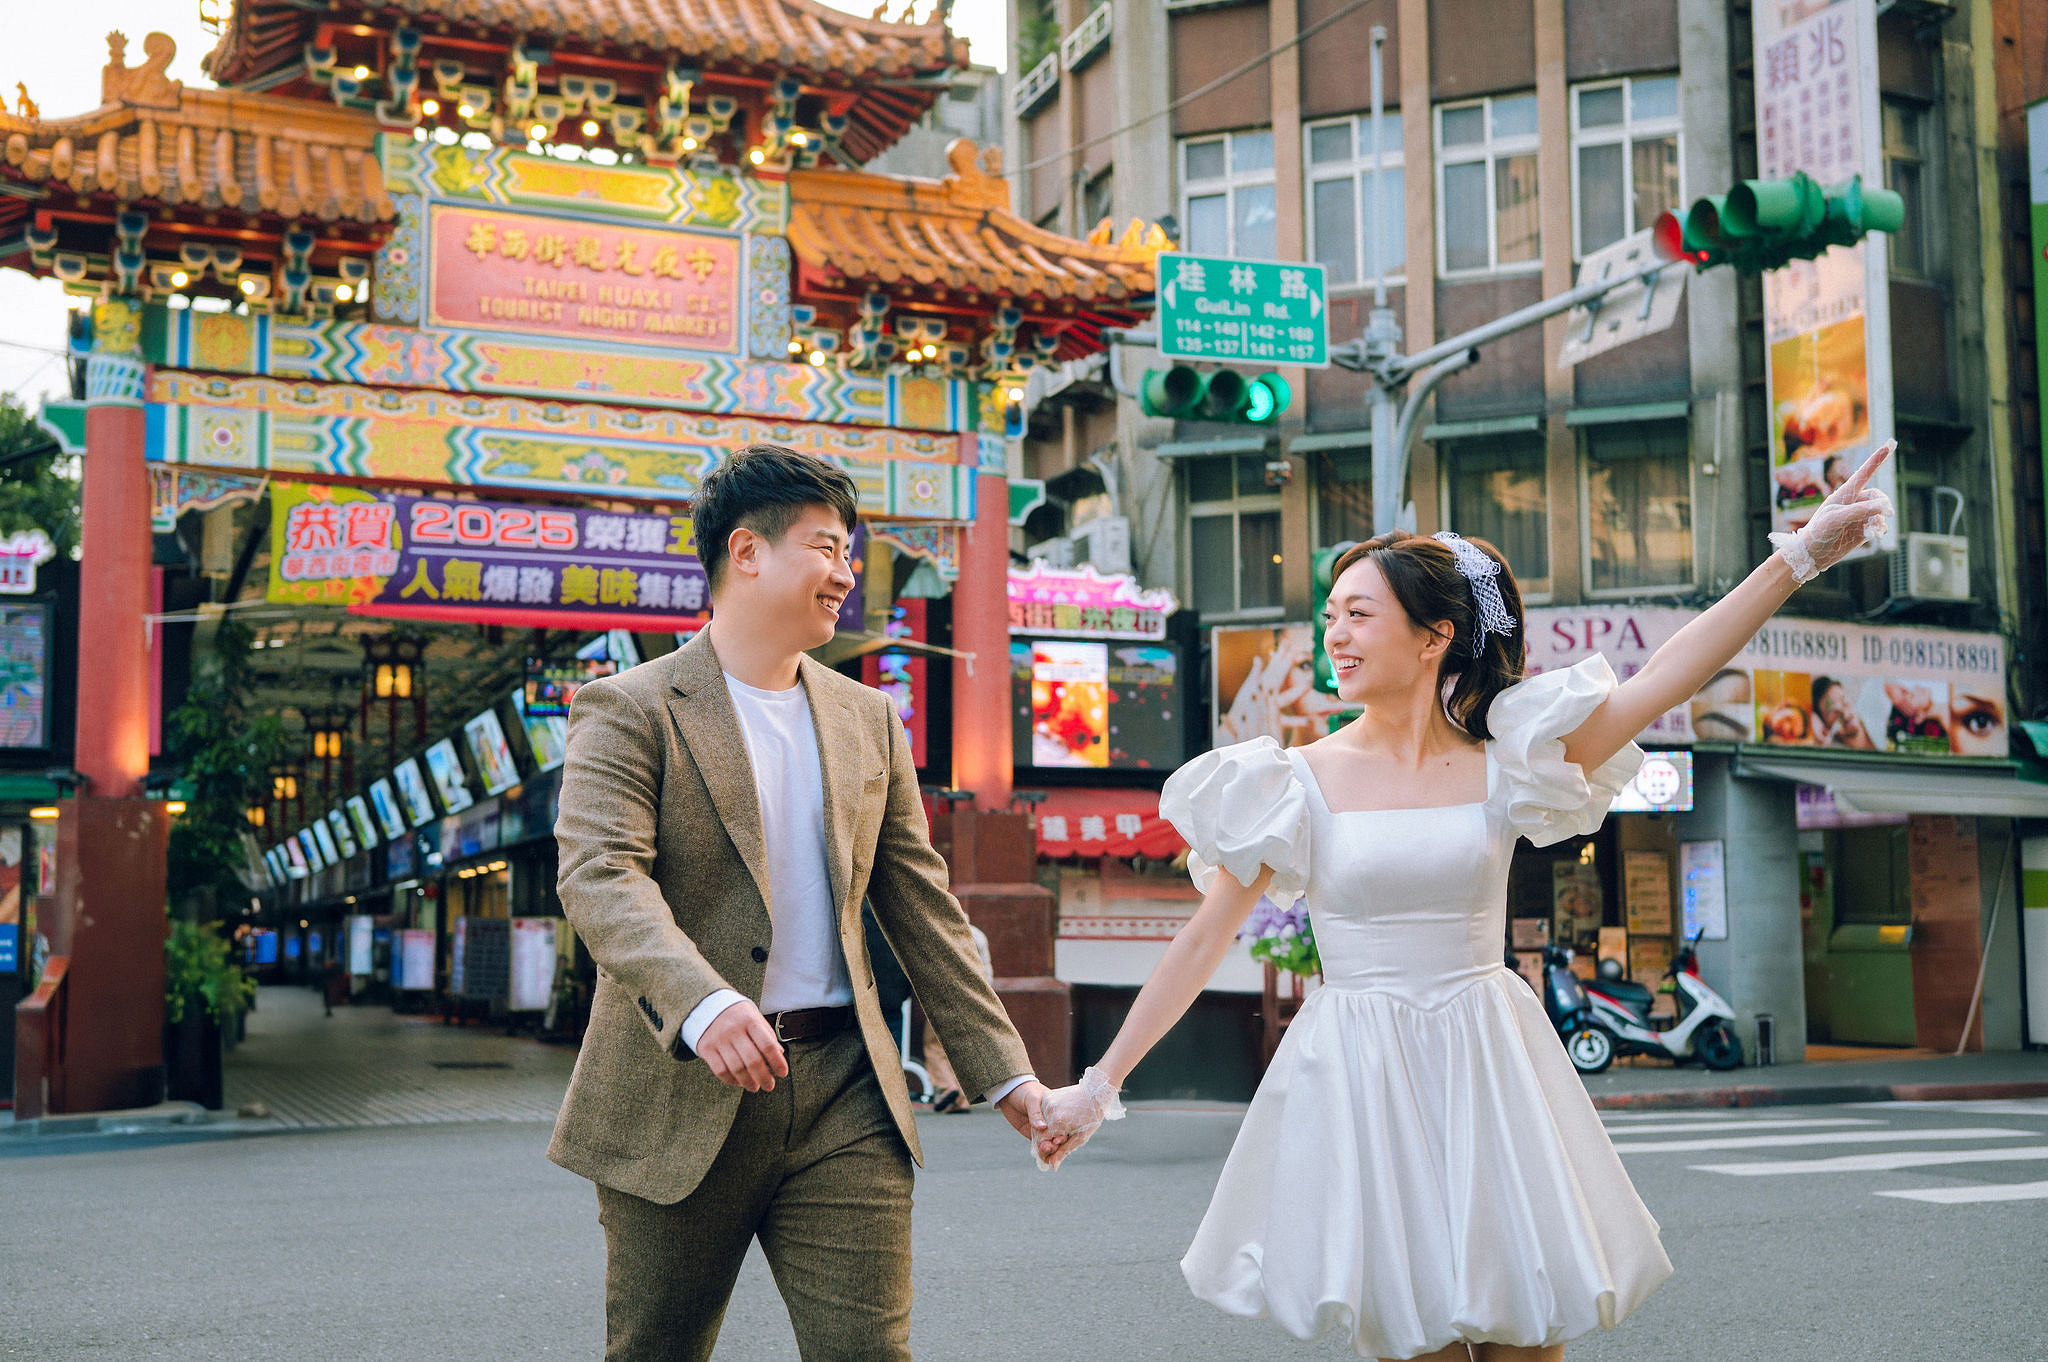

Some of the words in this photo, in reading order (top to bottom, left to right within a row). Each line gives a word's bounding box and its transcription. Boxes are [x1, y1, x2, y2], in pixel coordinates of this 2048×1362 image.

[465, 222, 716, 284] 華西街觀光夜市
[523, 276, 587, 303] TAIPEI
[598, 284, 672, 312] HUAXI
[1176, 259, 1309, 299] 桂林路
[479, 296, 563, 323] TOURIST
[578, 304, 637, 331] NIGHT
[643, 312, 716, 337] MARKET
[288, 503, 394, 551] 恭賀
[413, 504, 576, 548] 2025
[1552, 615, 1646, 651] SPA
